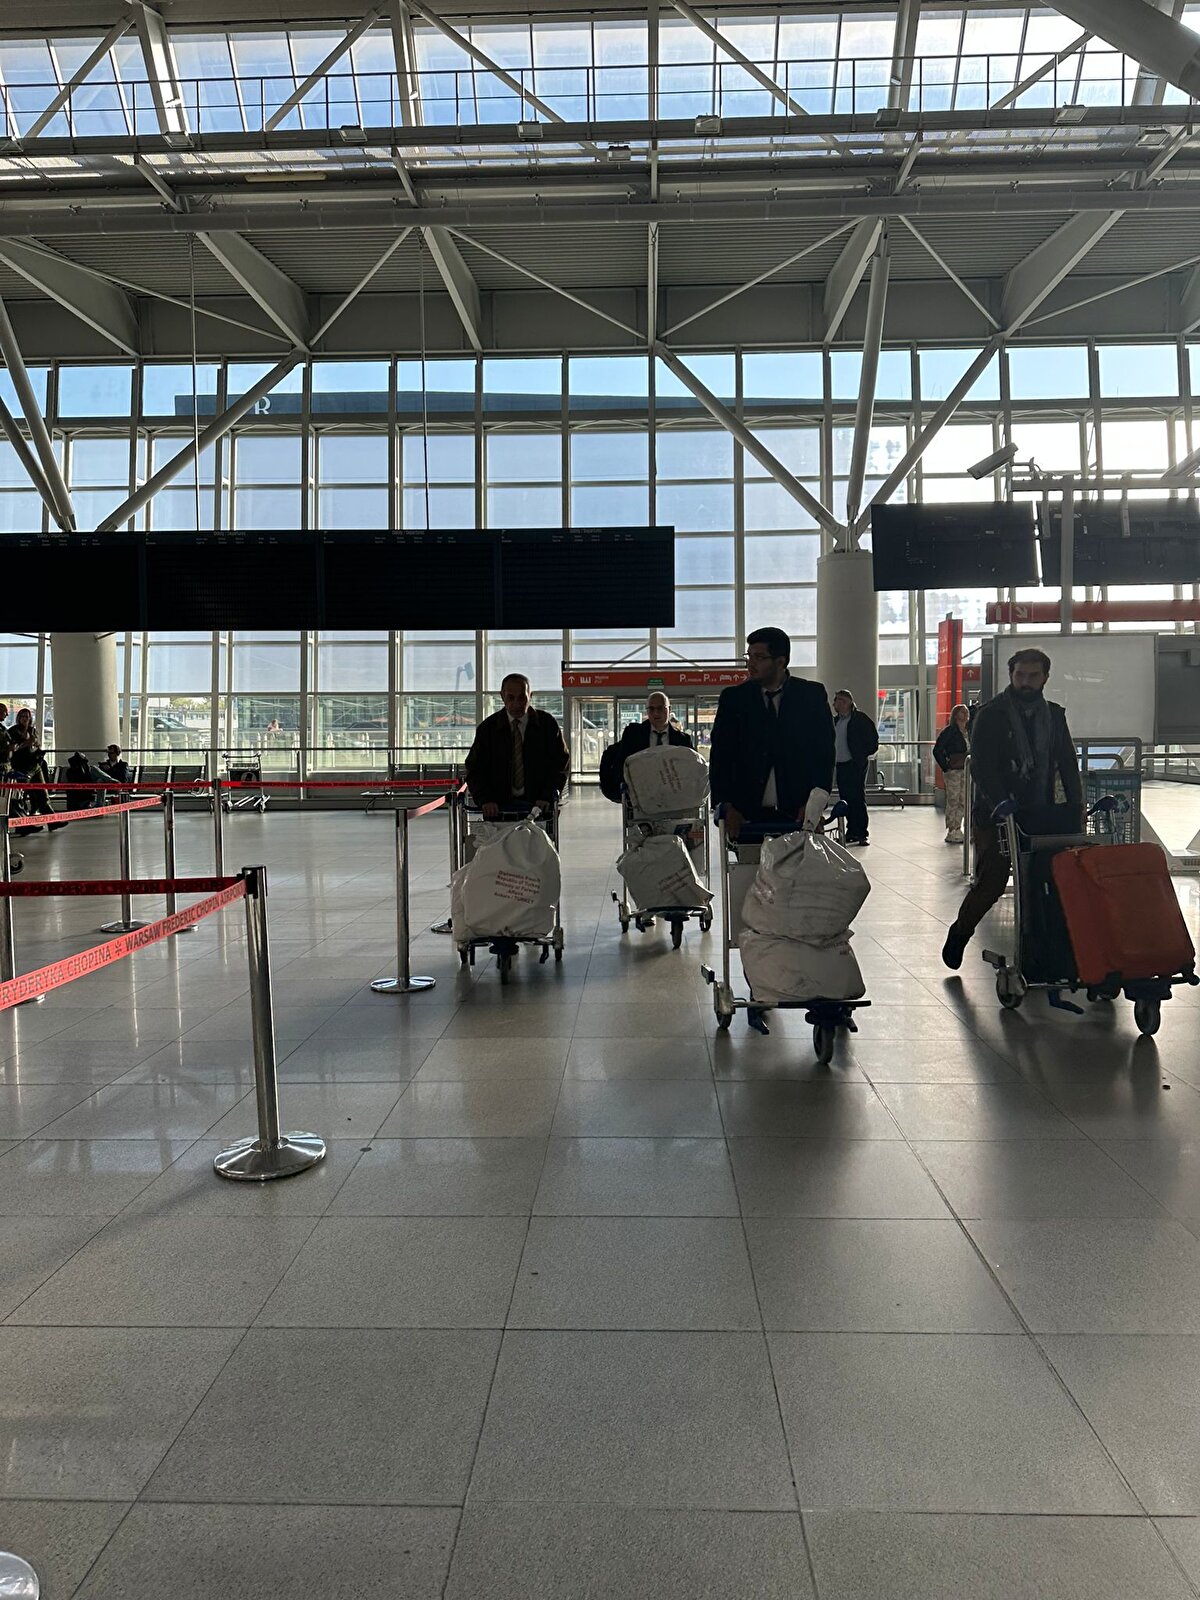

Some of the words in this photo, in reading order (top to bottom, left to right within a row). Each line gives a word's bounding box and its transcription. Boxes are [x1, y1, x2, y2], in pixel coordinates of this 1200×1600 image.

[0, 965, 65, 1005] RYDERYKA
[67, 945, 112, 977] CHOPINA
[125, 923, 162, 951] WARSAW
[162, 910, 196, 935] FREDERIC
[196, 895, 220, 917] CHOPIN
